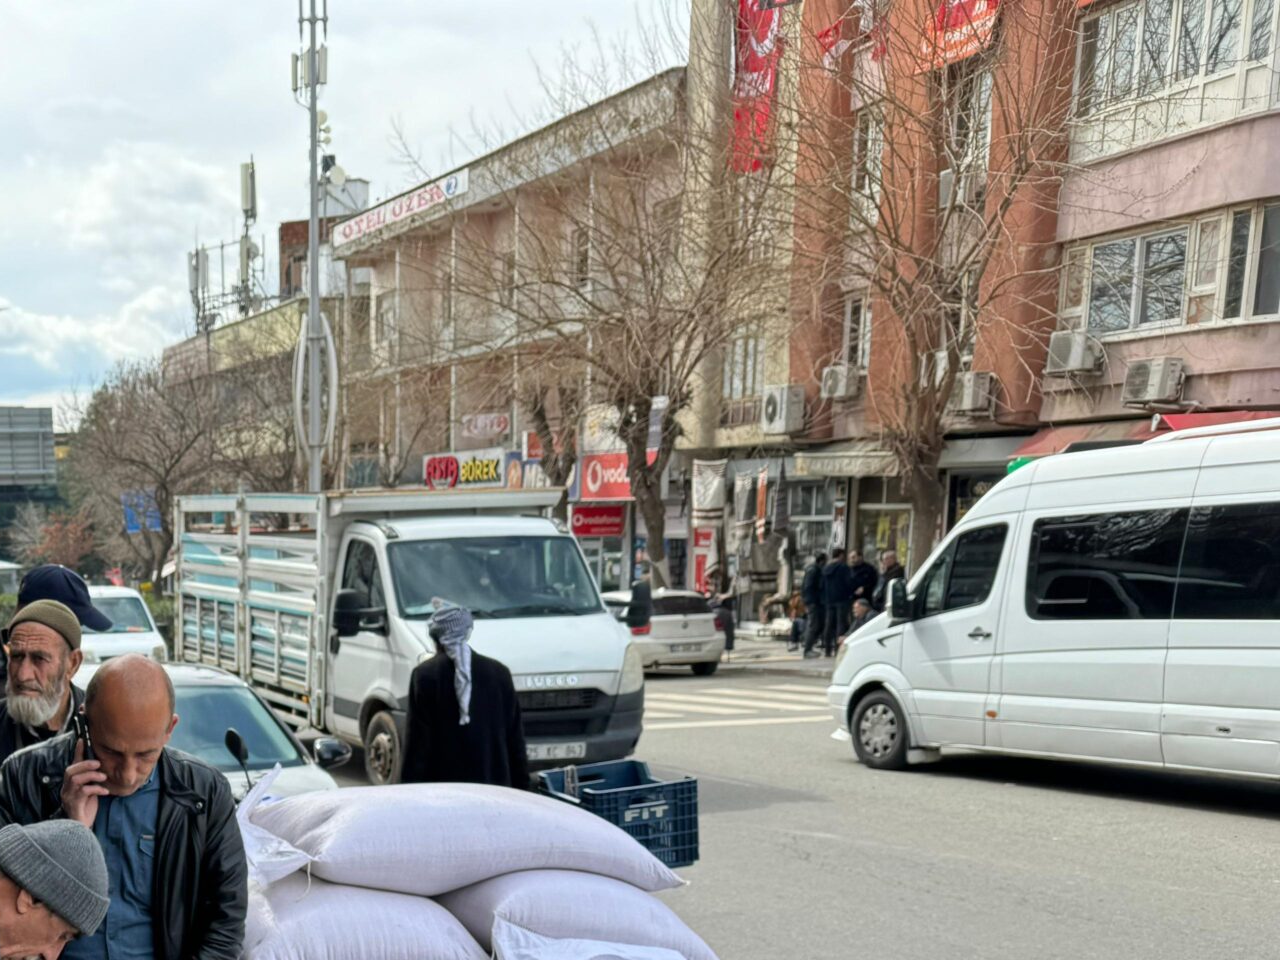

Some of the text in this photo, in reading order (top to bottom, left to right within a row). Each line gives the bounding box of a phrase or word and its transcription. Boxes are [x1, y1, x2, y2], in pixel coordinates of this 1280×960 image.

[342, 208, 383, 239] OTEL
[460, 456, 498, 482] BÖREK
[624, 804, 669, 822] FIT
